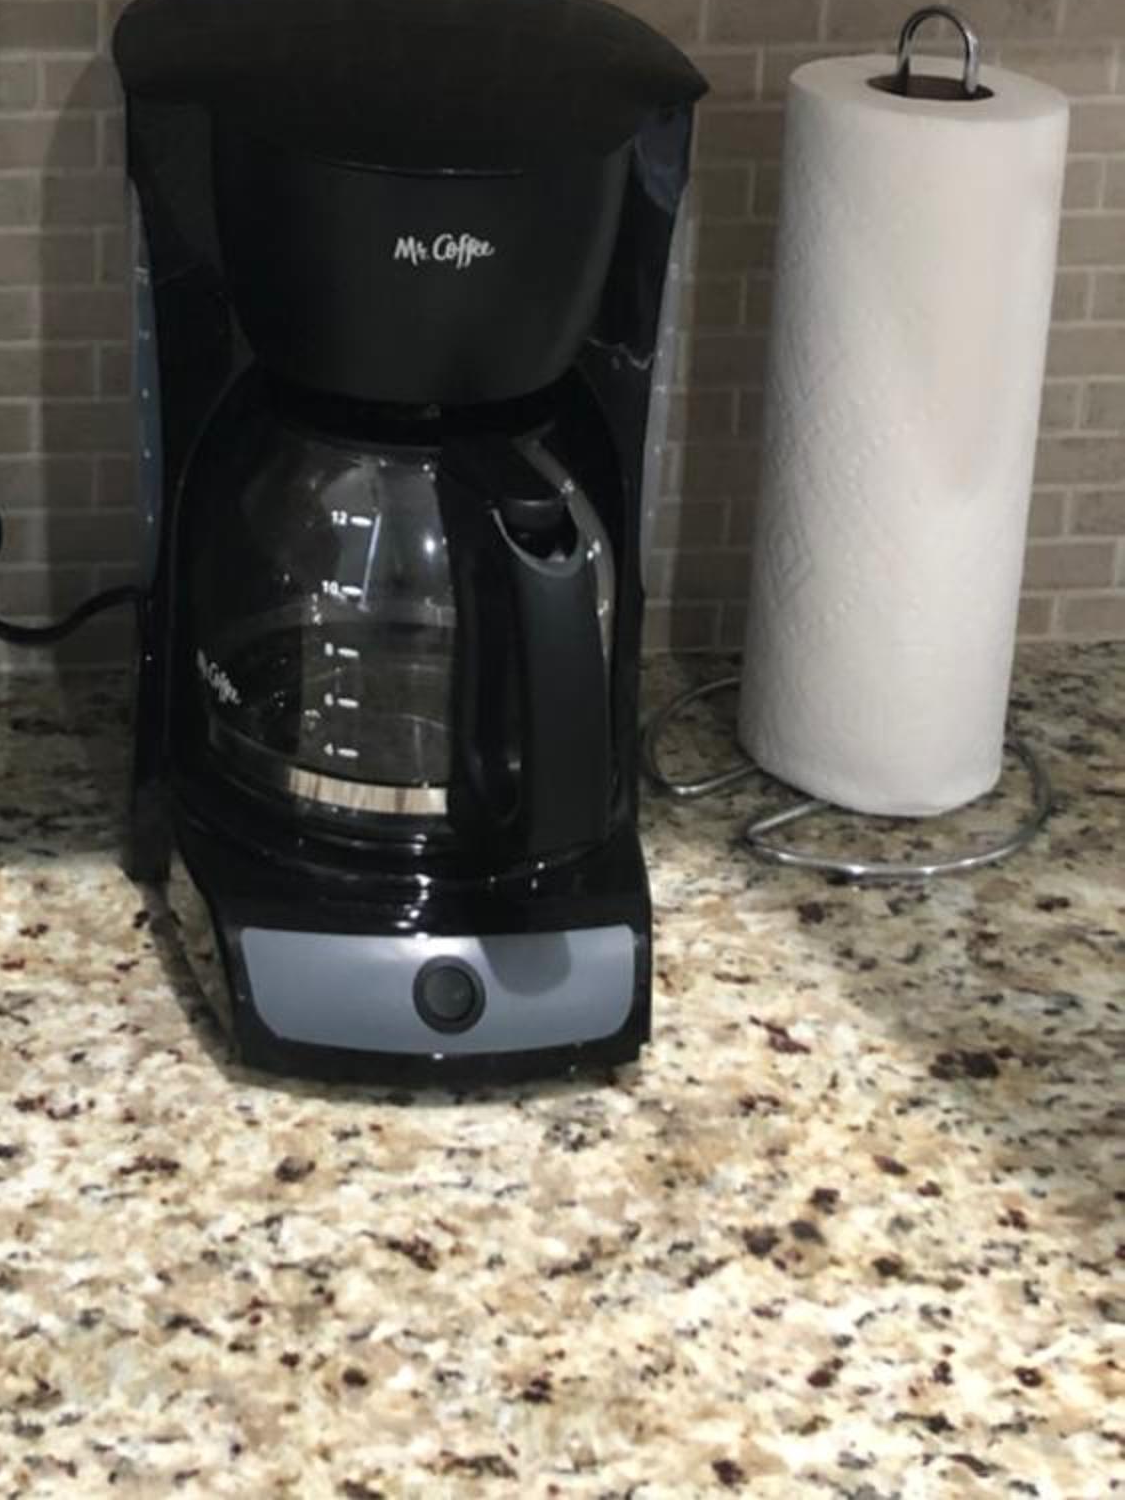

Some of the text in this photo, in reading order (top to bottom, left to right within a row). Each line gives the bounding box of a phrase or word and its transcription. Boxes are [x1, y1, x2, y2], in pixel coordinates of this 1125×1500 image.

[432, 233, 495, 270] Coffee
[331, 510, 348, 524] 12
[321, 580, 339, 595] 10
